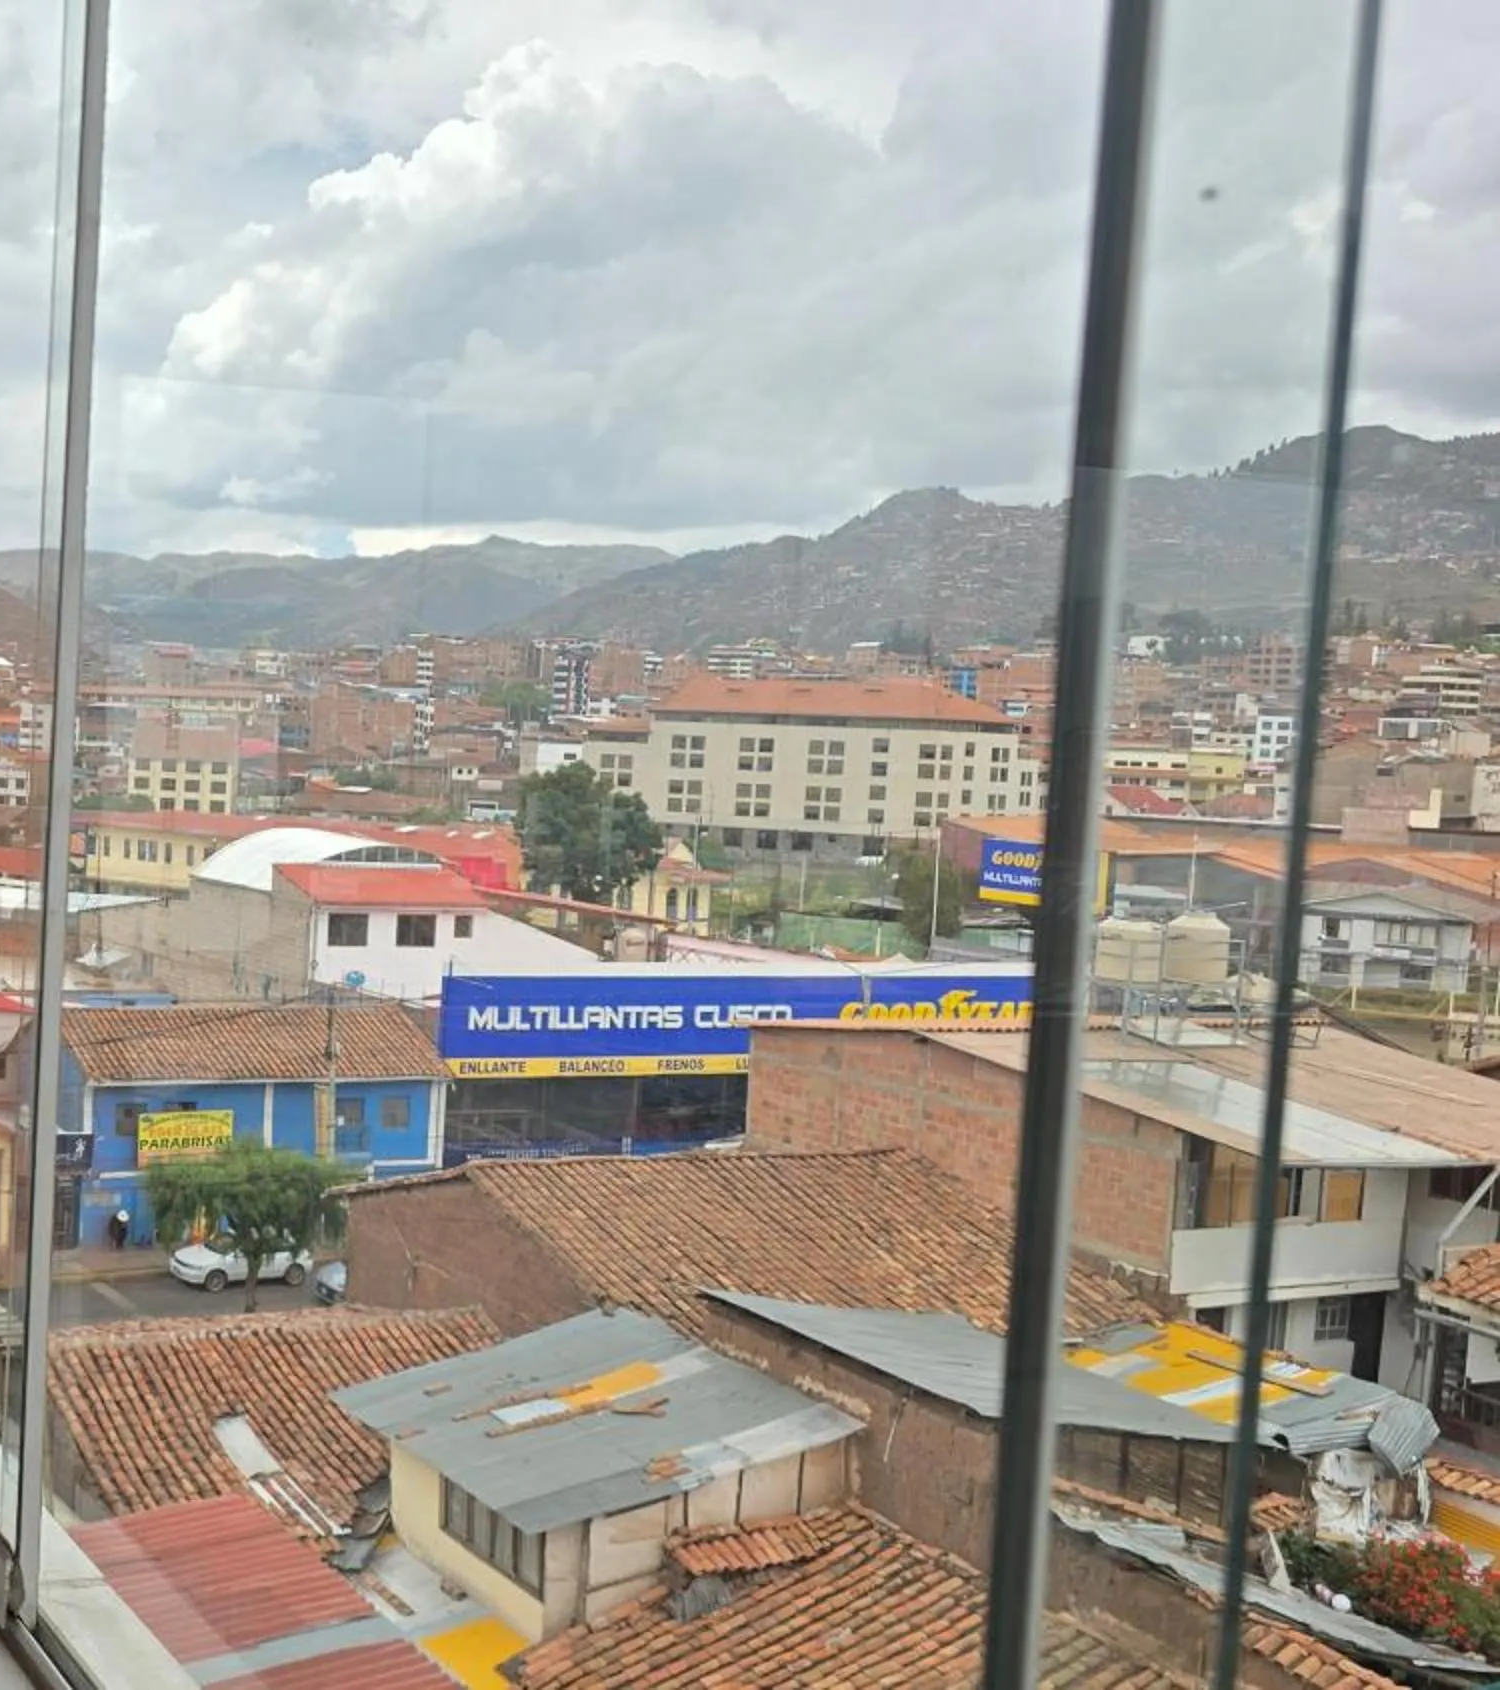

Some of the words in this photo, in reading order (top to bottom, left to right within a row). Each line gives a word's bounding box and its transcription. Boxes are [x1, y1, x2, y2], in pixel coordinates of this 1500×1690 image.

[468, 1005, 683, 1031] MULTILLANTAS
[694, 1004, 792, 1028] CUSCO
[459, 1061, 527, 1074] ENLLANTE
[559, 1059, 625, 1073] BALANCEO
[657, 1058, 705, 1071] FRENOS
